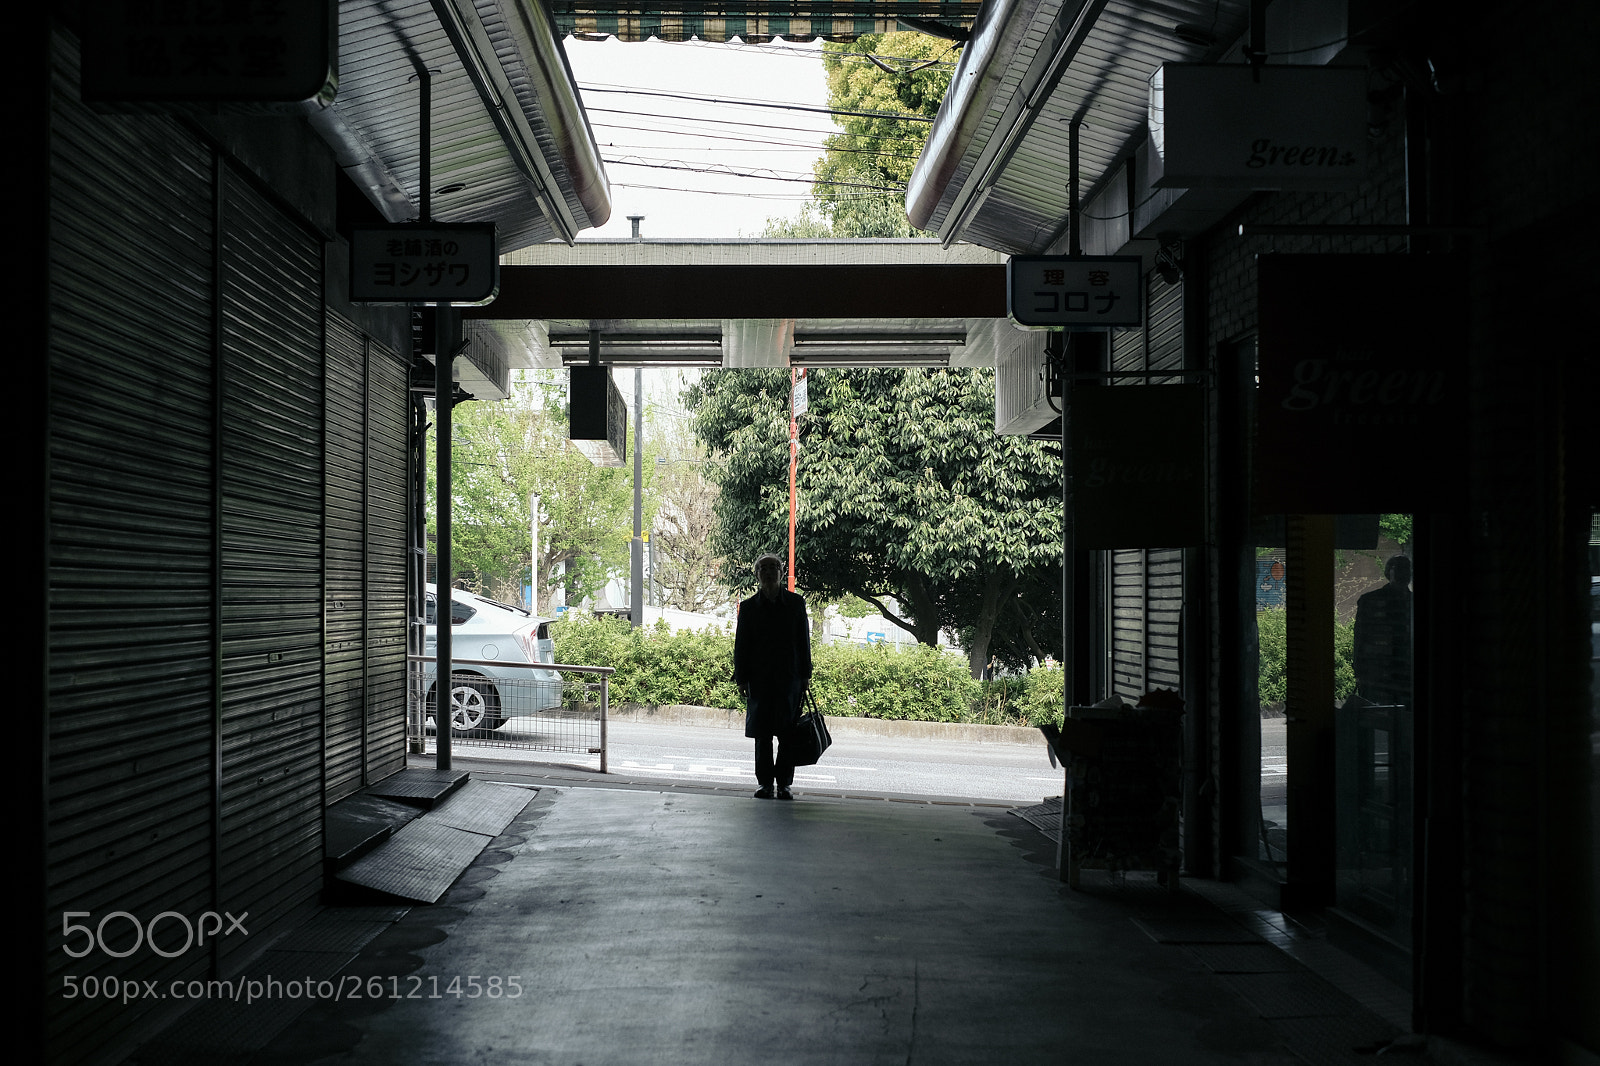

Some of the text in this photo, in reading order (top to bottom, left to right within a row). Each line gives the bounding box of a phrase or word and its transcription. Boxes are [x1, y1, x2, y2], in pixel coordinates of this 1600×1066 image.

[1246, 138, 1337, 168] green
[386, 238, 459, 257] 老舗酒の
[374, 261, 470, 287] ヨシザワ
[1044, 269, 1109, 286] 理容
[1034, 291, 1120, 314] コロナ
[1281, 358, 1449, 411] green
